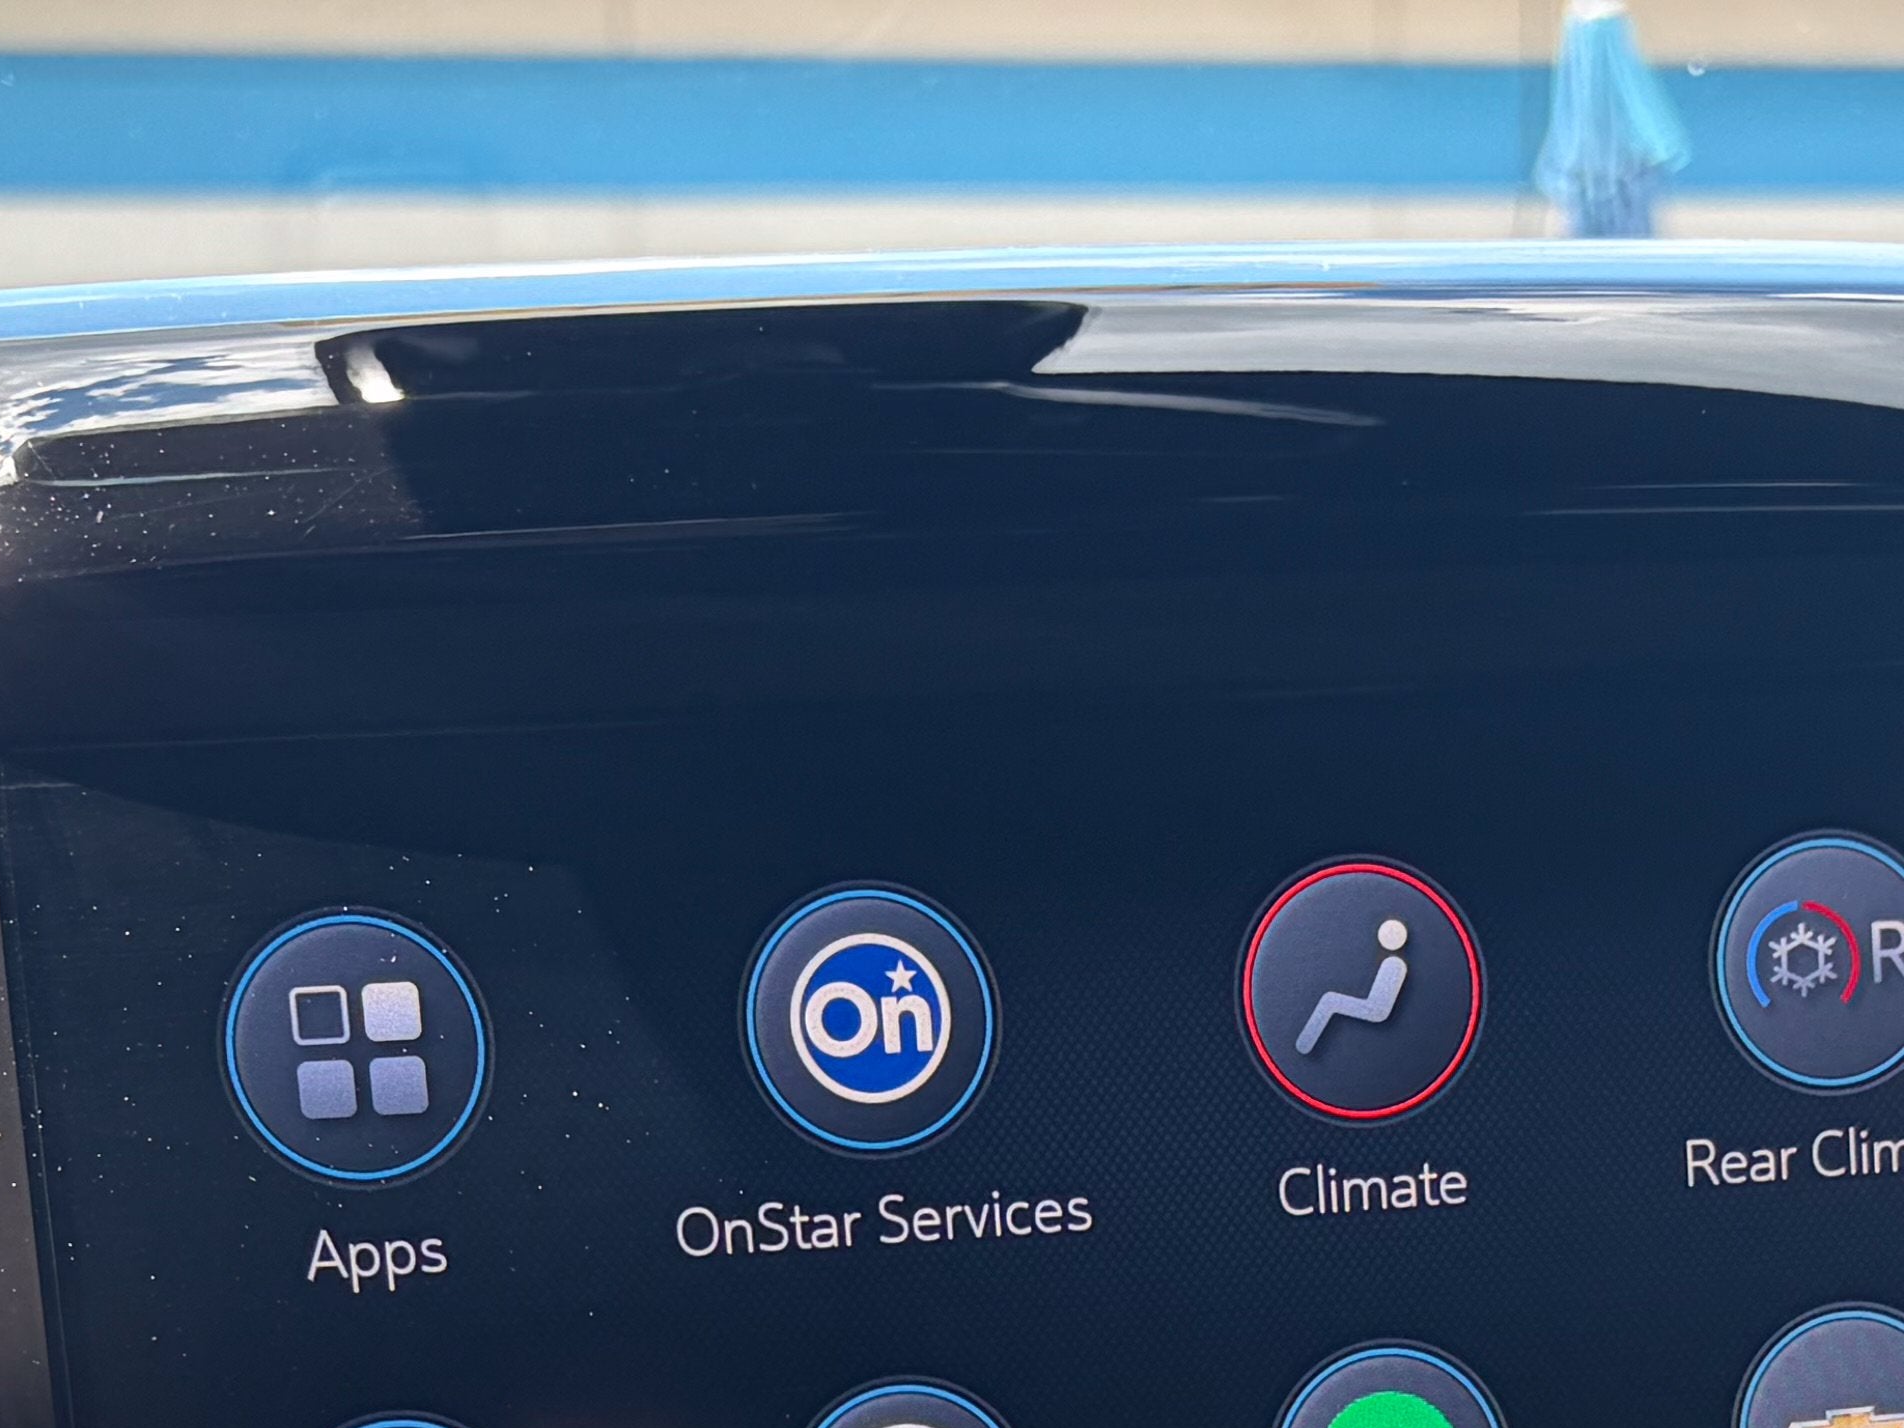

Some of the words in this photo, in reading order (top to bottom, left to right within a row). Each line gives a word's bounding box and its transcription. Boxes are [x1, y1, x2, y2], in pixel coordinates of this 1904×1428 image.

[803, 981, 934, 1058] On
[1278, 1161, 1468, 1217] Climate
[1685, 1137, 1798, 1188] Rear
[675, 1201, 862, 1258] OnStar
[877, 1189, 1094, 1246] Services
[306, 1228, 449, 1294] Apps
